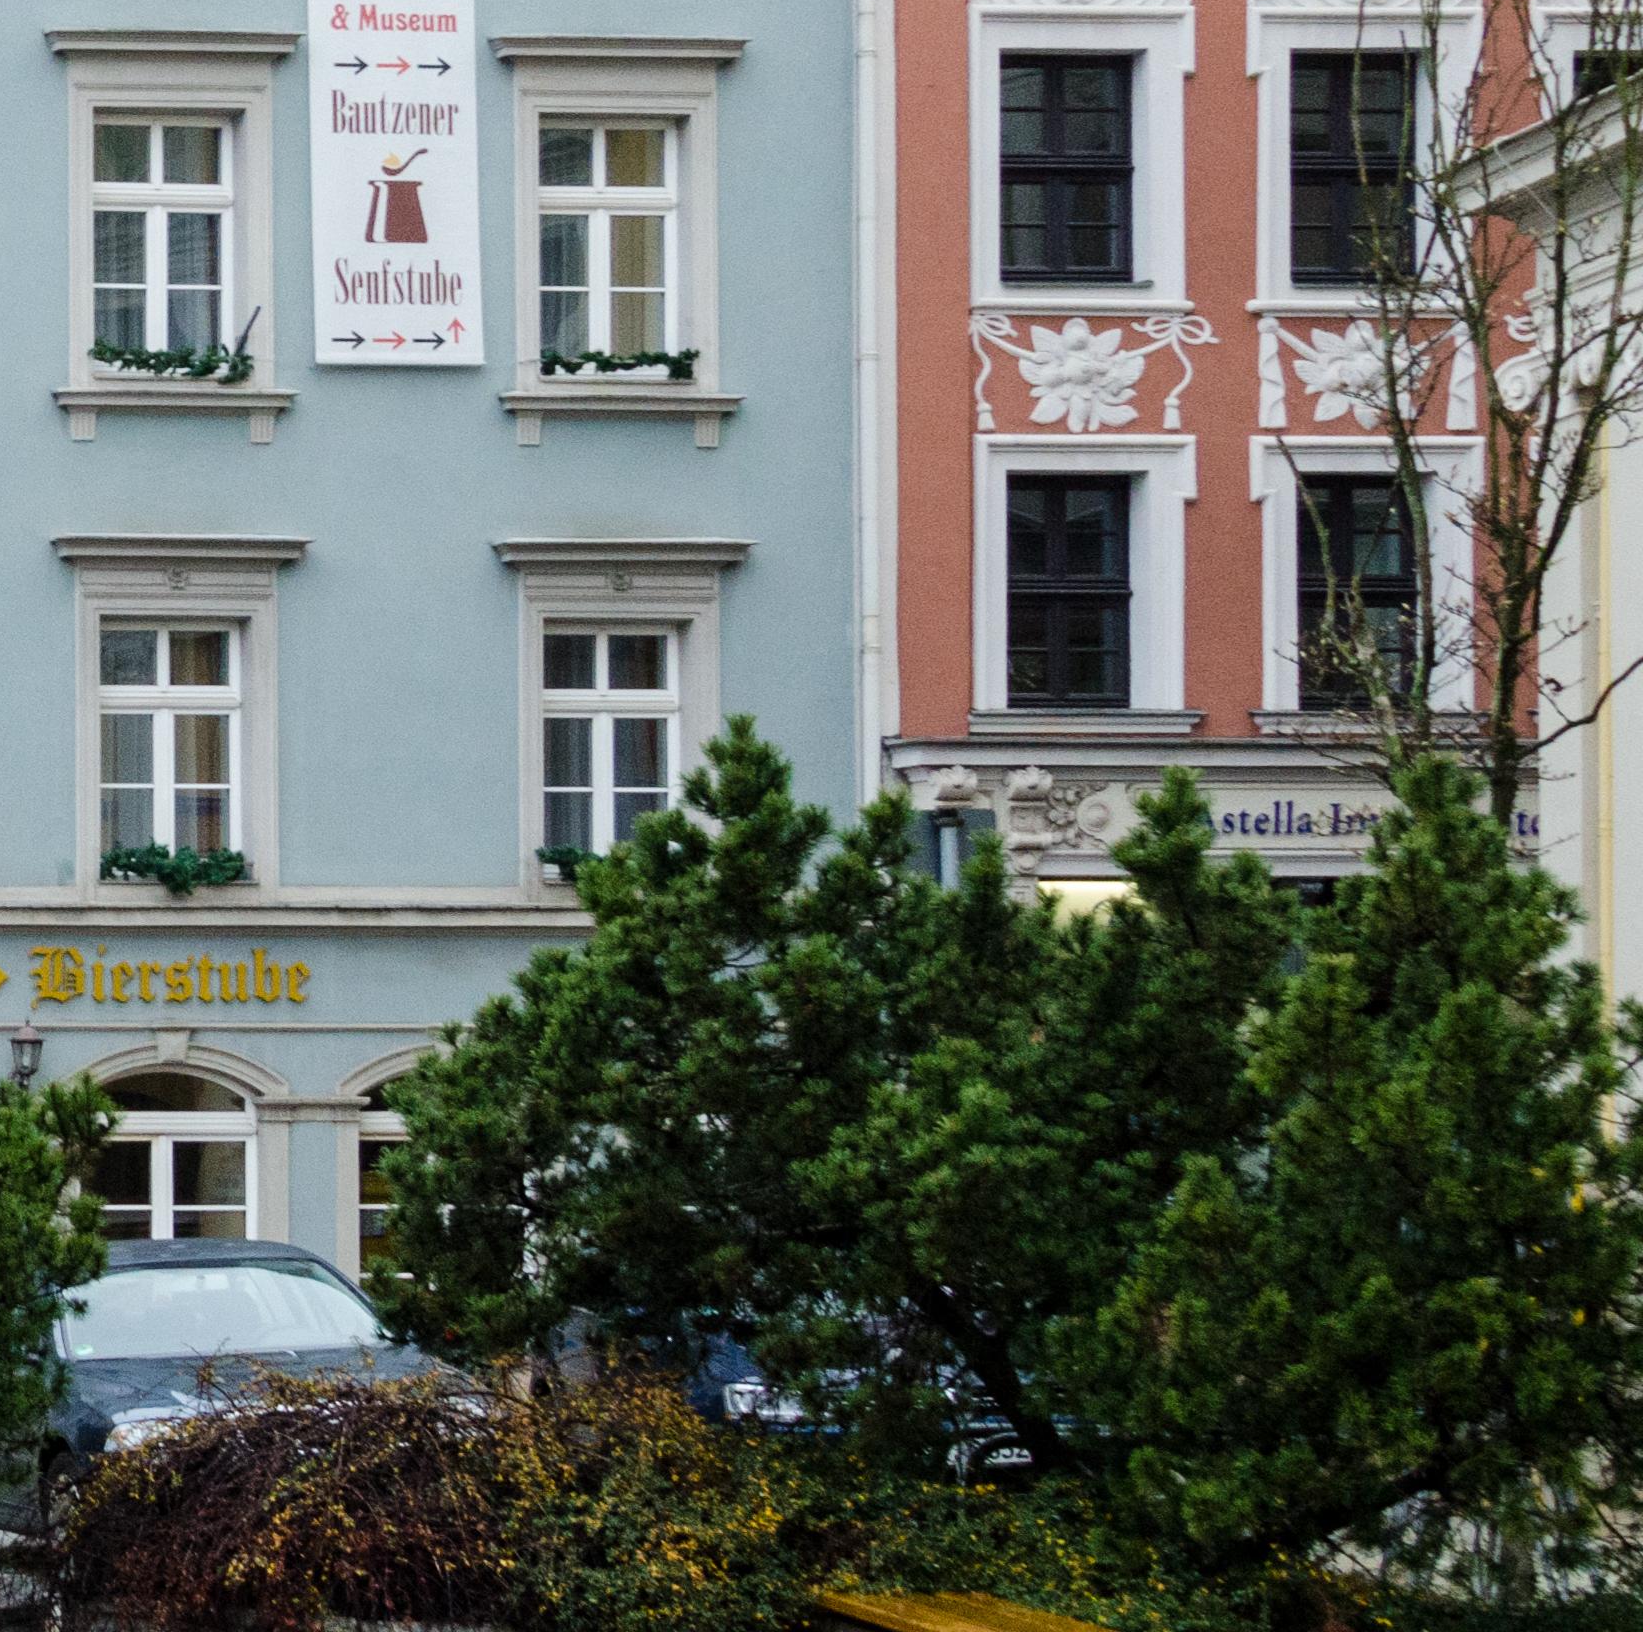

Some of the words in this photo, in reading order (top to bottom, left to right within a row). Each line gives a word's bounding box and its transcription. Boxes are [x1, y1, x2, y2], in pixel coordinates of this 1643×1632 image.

[331, 3, 349, 30] &
[358, 3, 458, 33] Museum
[331, 89, 459, 136] Bautzener
[334, 257, 463, 306] Senfstube
[28, 943, 311, 1010] Bierstube
